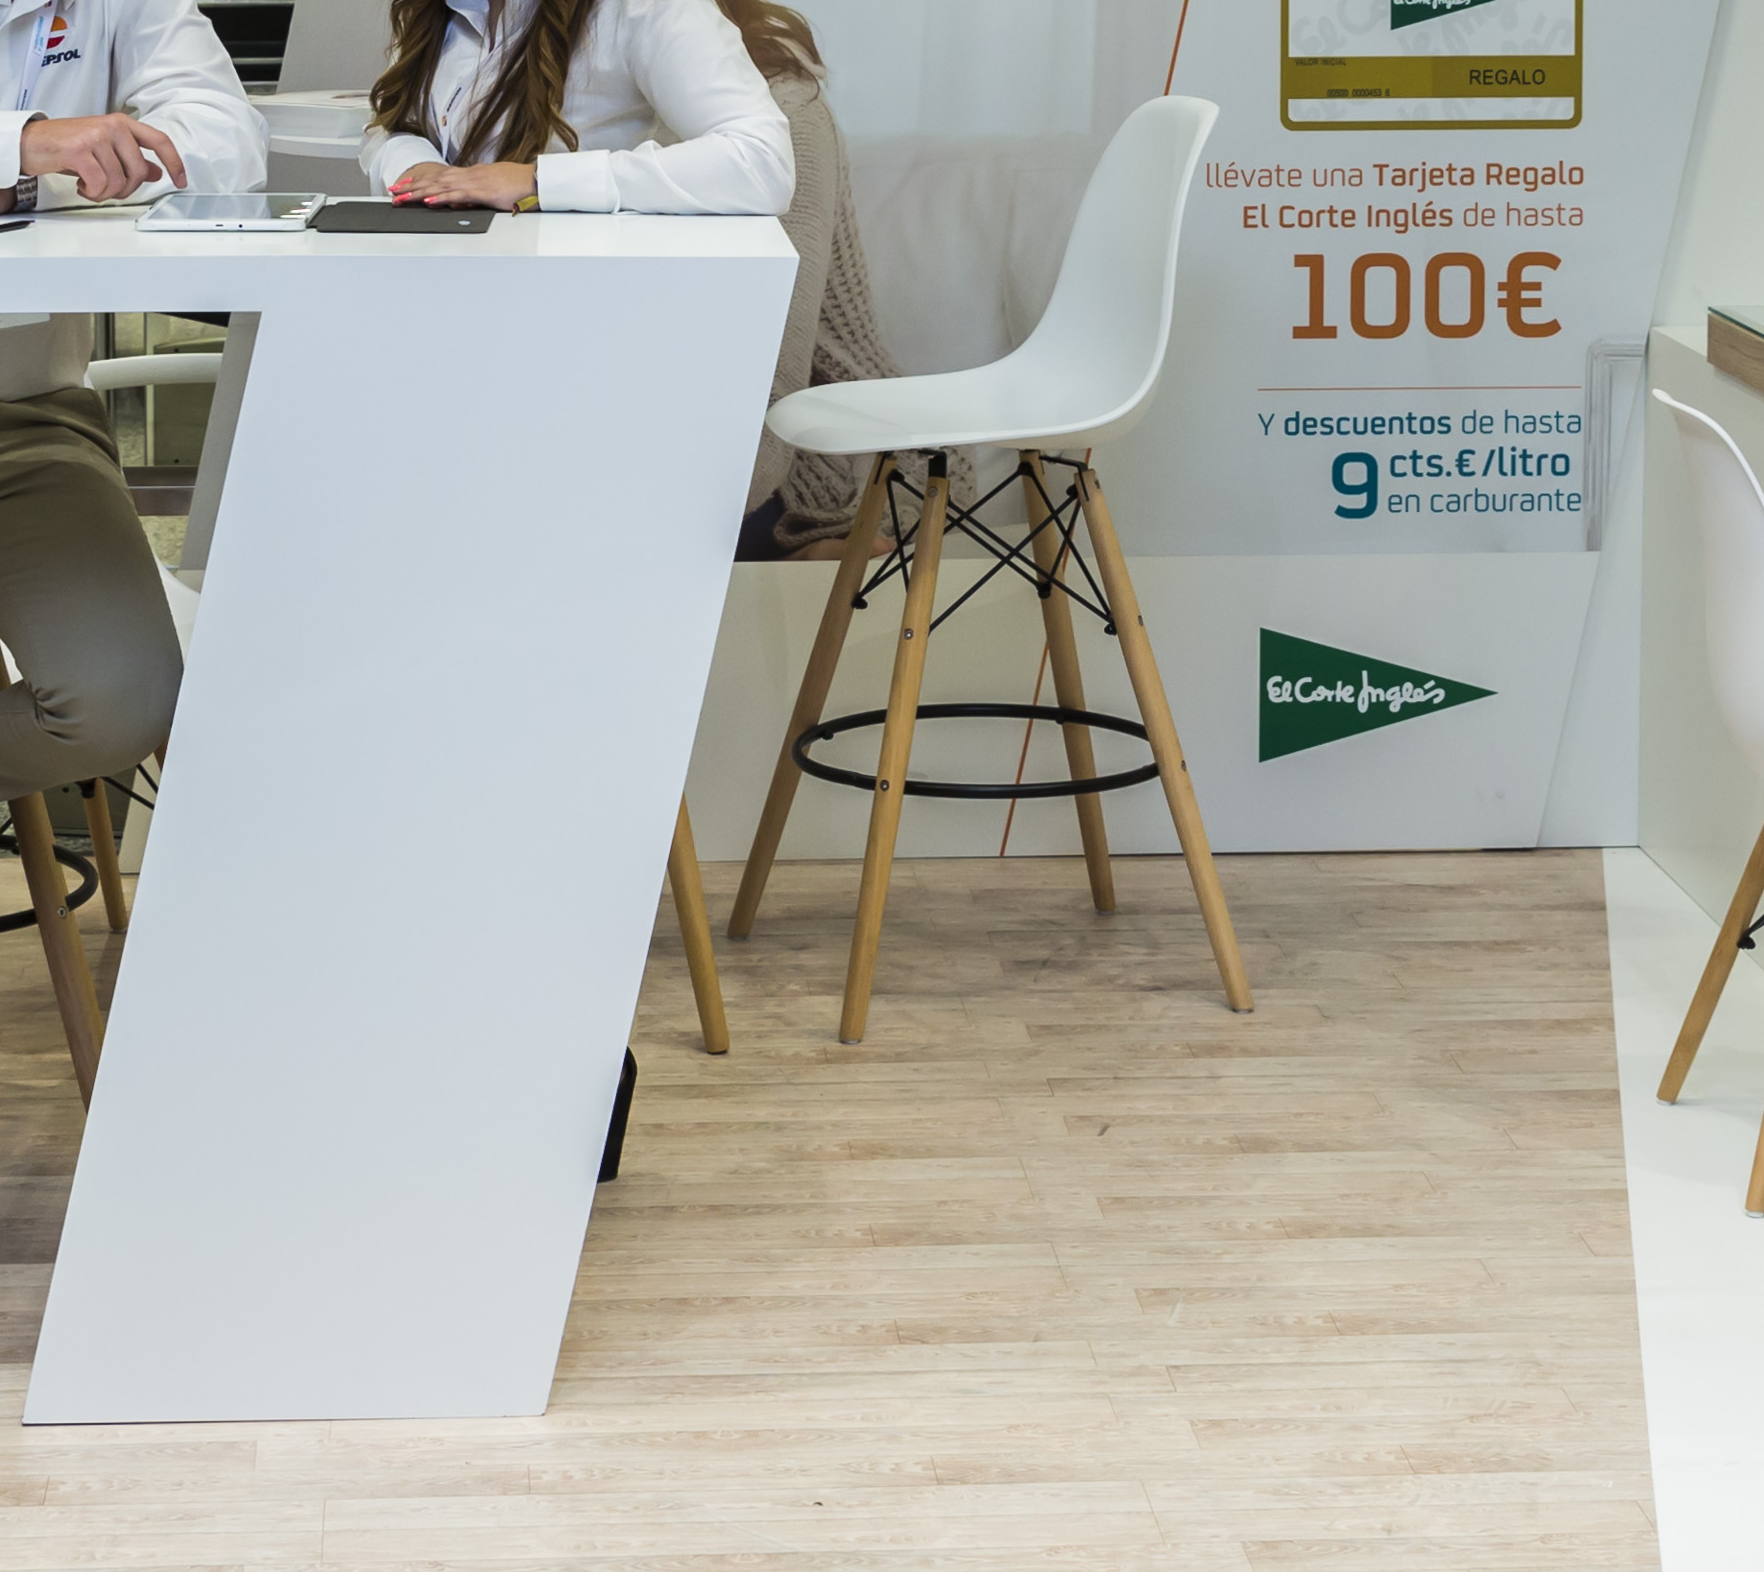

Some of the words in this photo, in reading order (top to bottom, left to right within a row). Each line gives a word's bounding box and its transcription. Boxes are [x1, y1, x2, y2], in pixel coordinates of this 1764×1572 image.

[41, 49, 81, 67] EPSOL
[1468, 68, 1547, 86] REGALO
[1205, 161, 1303, 188] llévate
[1312, 166, 1364, 188] una
[1372, 161, 1476, 193] Tarjeta
[1486, 160, 1585, 192] Regalo
[1243, 203, 1270, 228] El
[1278, 203, 1356, 229] Corte
[1366, 201, 1453, 234] Inglés
[1463, 202, 1496, 227] de
[1506, 201, 1584, 227] hasta
[1292, 251, 1562, 339] 100€
[1258, 412, 1275, 436] Y
[1284, 411, 1452, 436] descuentos
[1461, 410, 1494, 434] de
[1504, 409, 1582, 434] hasta
[1331, 452, 1379, 519] 9
[1387, 493, 1420, 513] en
[1430, 488, 1582, 513] carburante
[1266, 675, 1293, 703] El
[1294, 677, 1354, 703] Corte
[1357, 670, 1445, 713] Inglés
